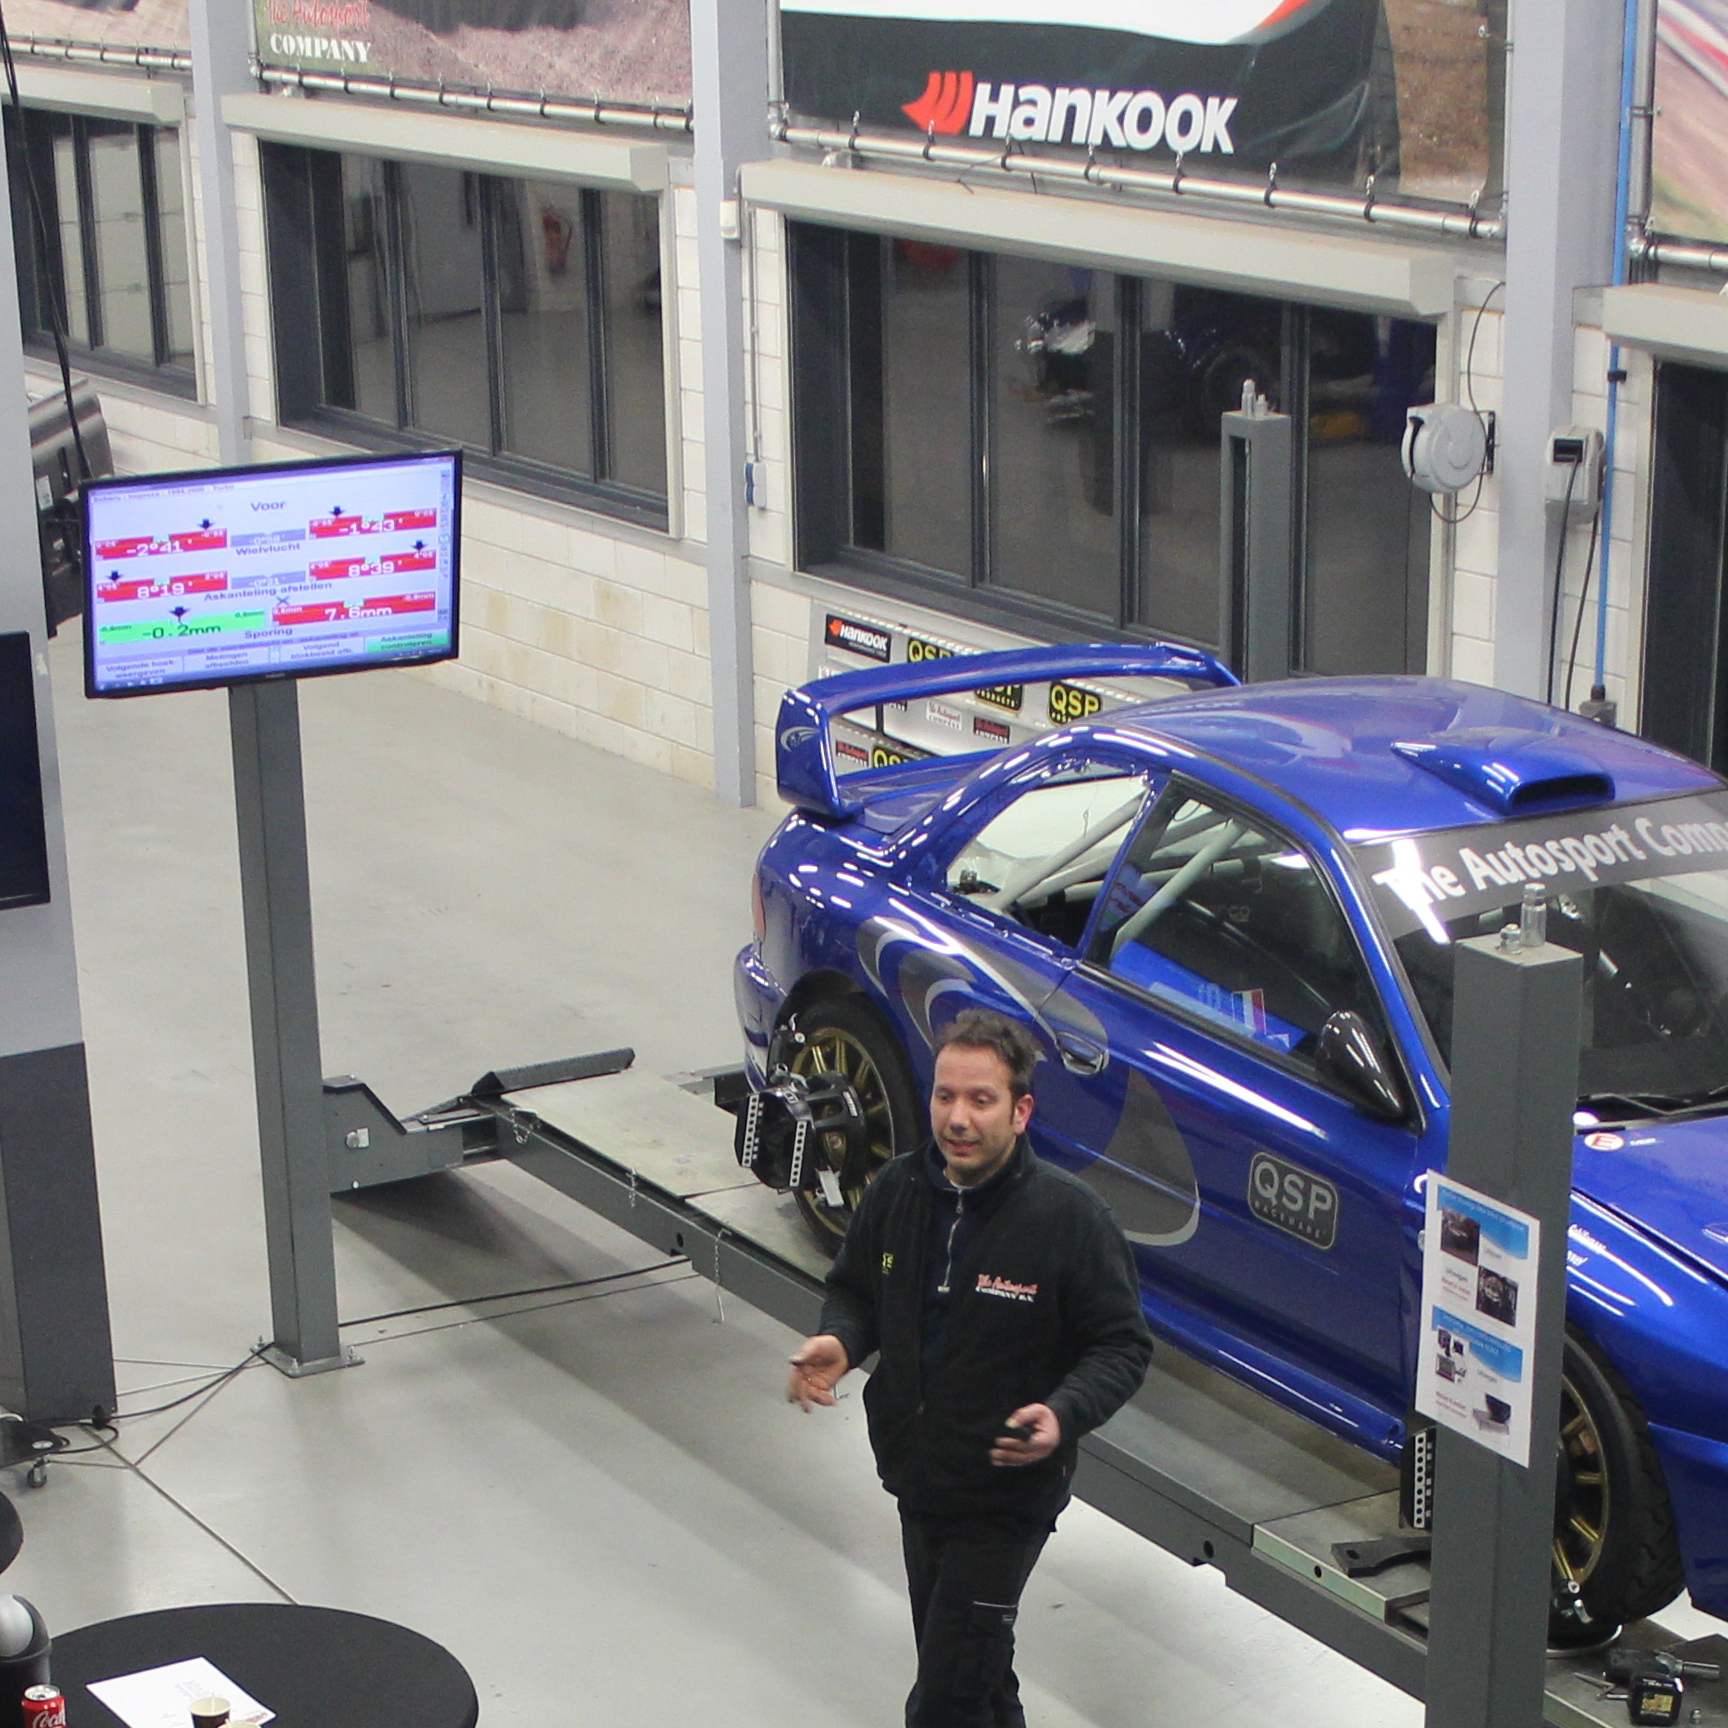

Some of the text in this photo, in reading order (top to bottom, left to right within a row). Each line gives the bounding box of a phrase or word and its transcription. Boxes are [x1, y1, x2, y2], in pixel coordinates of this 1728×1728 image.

[269, 32, 372, 63] COMPANY
[250, 501, 286, 512] Voor
[236, 541, 301, 556] Wielvlucht
[203, 581, 332, 602] Askanteling afstellen
[244, 627, 293, 641] Sporing
[1051, 684, 1100, 718] QSP
[1459, 824, 1648, 891] Autosport
[1253, 1160, 1332, 1220] QSP
[1254, 1201, 1323, 1239] RACEWARE
